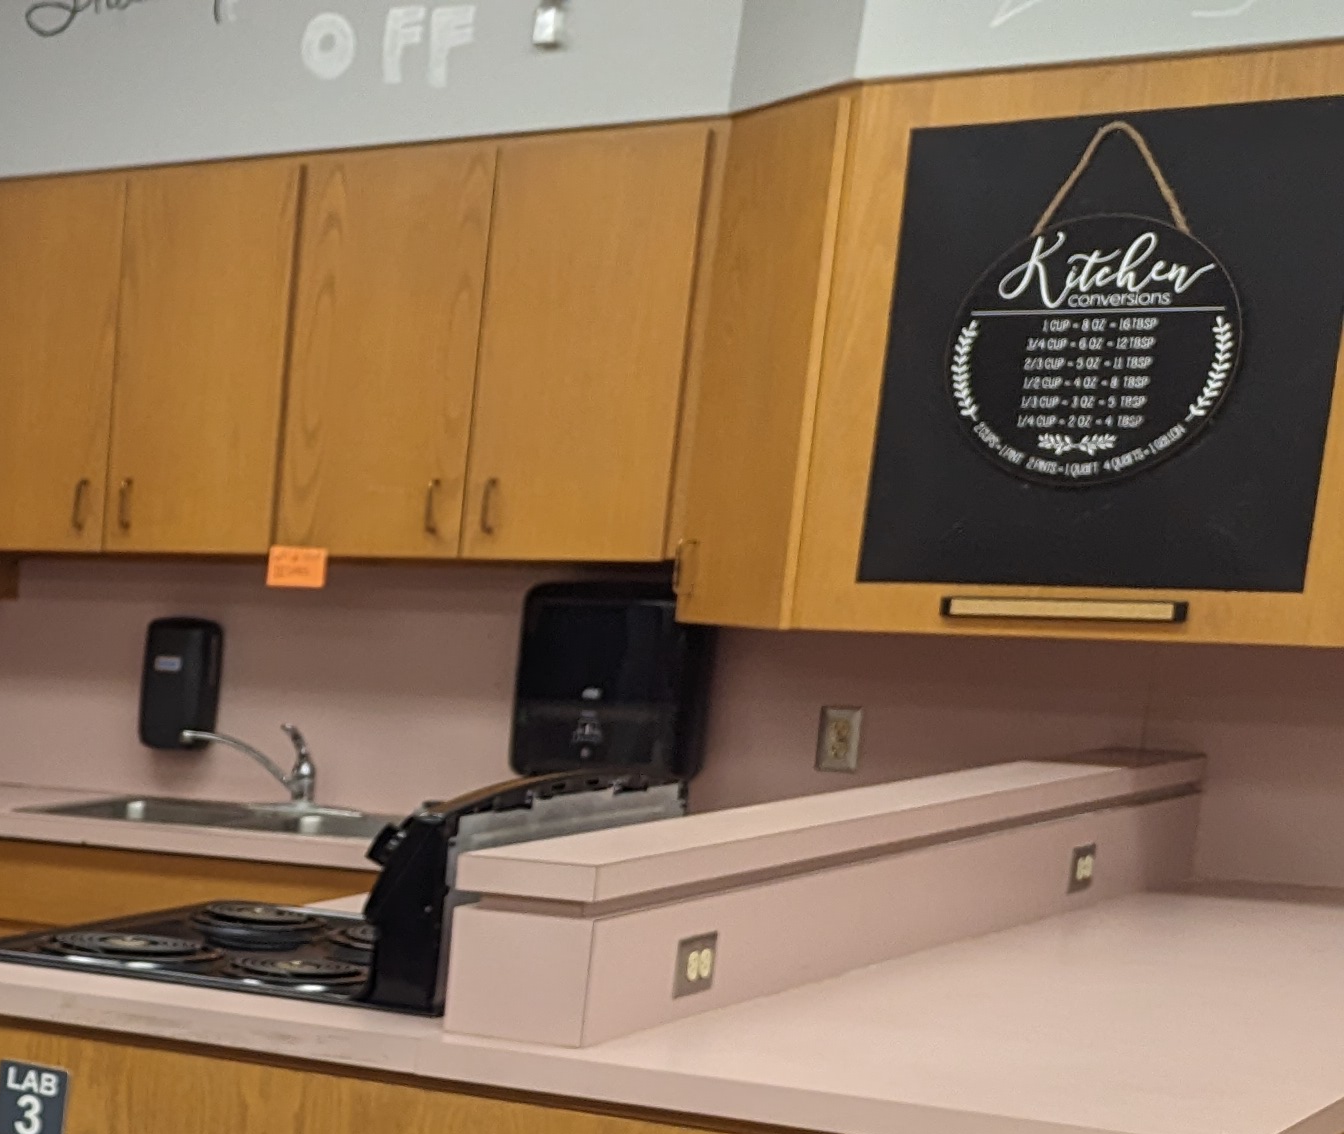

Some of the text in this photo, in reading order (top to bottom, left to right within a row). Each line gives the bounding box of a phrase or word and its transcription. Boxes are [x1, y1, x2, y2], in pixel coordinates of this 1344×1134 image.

[300, 5, 476, 87] OFF
[999, 232, 1216, 309] Kitchen
[1067, 291, 1172, 308] conversions
[1050, 319, 1071, 332] CUP
[1092, 318, 1107, 331] OZ
[1047, 337, 1068, 350] CUP
[1089, 337, 1104, 350] OZ
[1044, 357, 1065, 370] CUP
[1086, 357, 1102, 370] OZ
[1041, 376, 1063, 389] CUP
[1083, 376, 1098, 389] OZ
[1039, 395, 1060, 408] CUP
[1080, 395, 1095, 408] OZ
[1036, 415, 1057, 428] CUP
[1077, 414, 1093, 428] OZ
[6, 1066, 59, 1097] LAB
